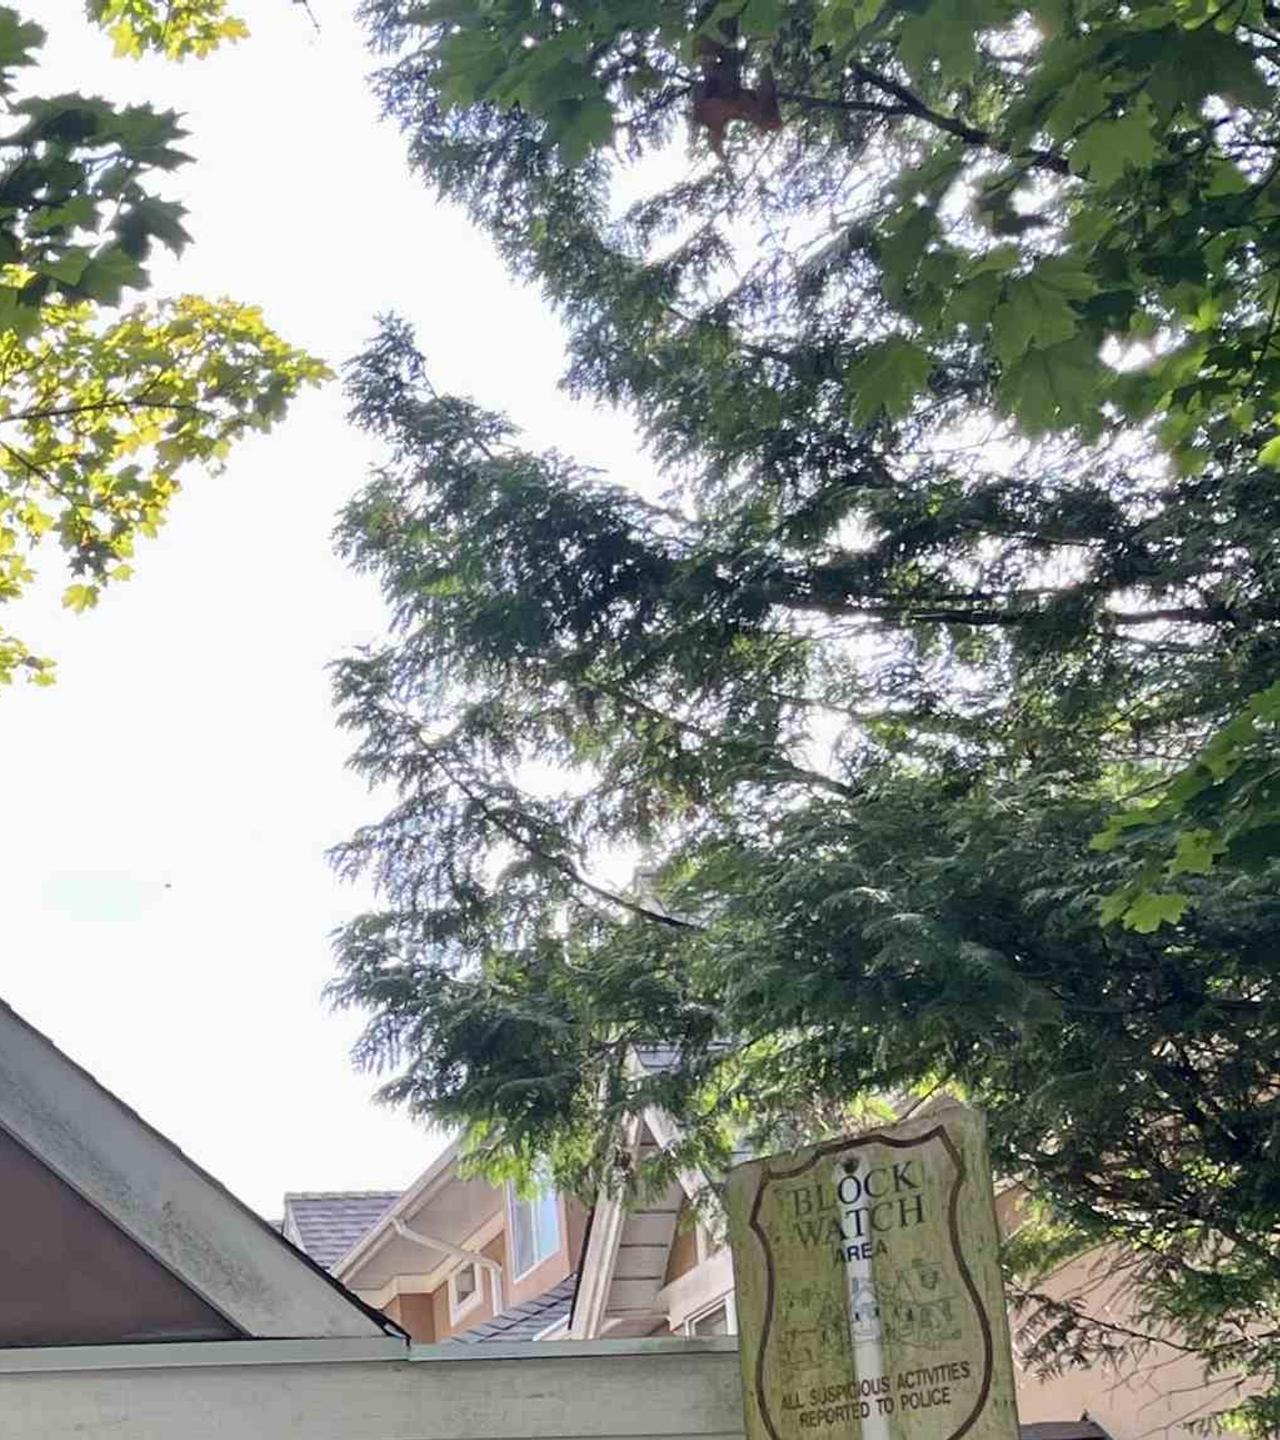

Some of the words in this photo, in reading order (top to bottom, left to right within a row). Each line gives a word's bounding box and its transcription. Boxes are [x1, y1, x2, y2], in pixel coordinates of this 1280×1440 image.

[791, 1160, 920, 1217] BLOCK
[792, 1193, 925, 1248] WATCH
[832, 1239, 888, 1268] AREA
[781, 1393, 804, 1410] ALL
[809, 1376, 890, 1407] SUSPICIOUS
[897, 1361, 971, 1391] ACTIVITIES
[800, 1401, 870, 1428] REPORTED
[876, 1397, 894, 1416] TO
[901, 1387, 951, 1411] POLICE
